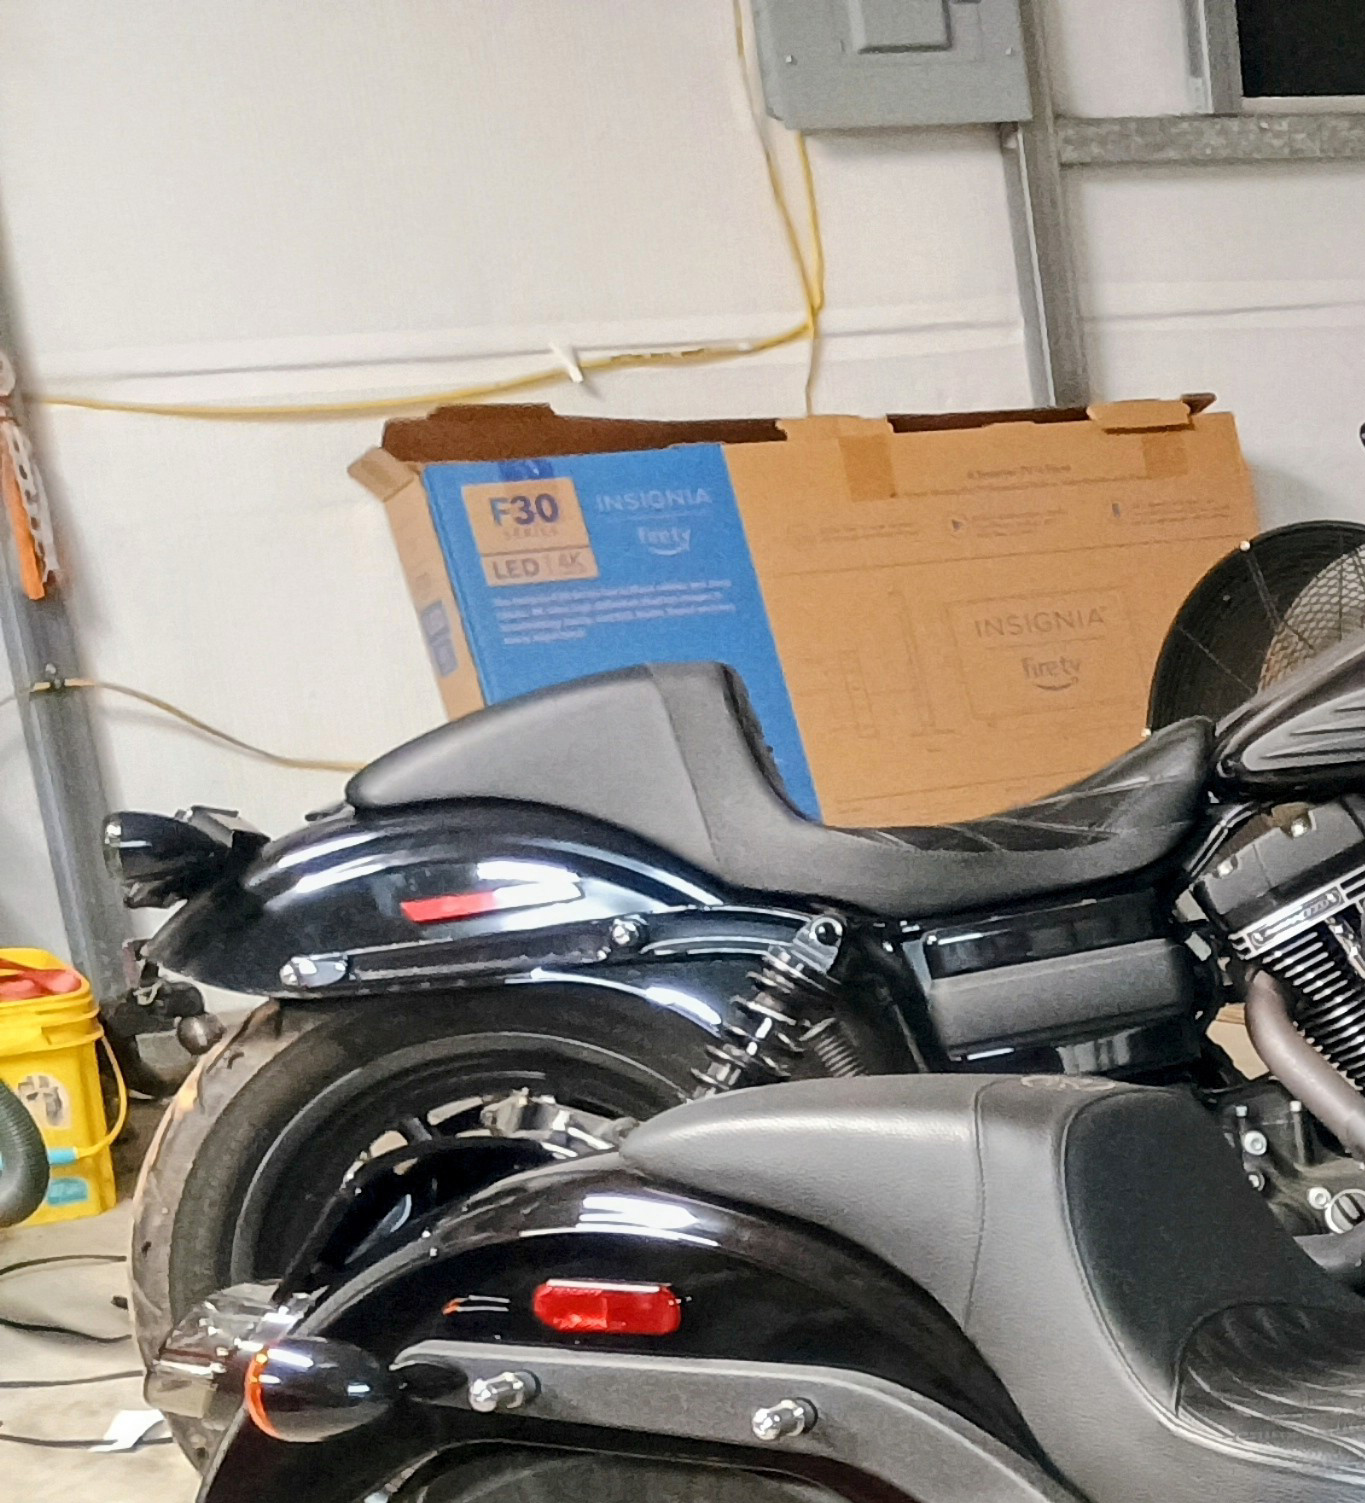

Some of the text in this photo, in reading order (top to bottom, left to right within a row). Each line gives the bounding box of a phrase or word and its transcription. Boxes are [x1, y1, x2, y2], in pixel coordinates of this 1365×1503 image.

[488, 492, 560, 526] F30
[595, 487, 713, 512] INSIGNIA
[492, 556, 541, 580] LED
[974, 610, 1105, 638] INSIGNIA
